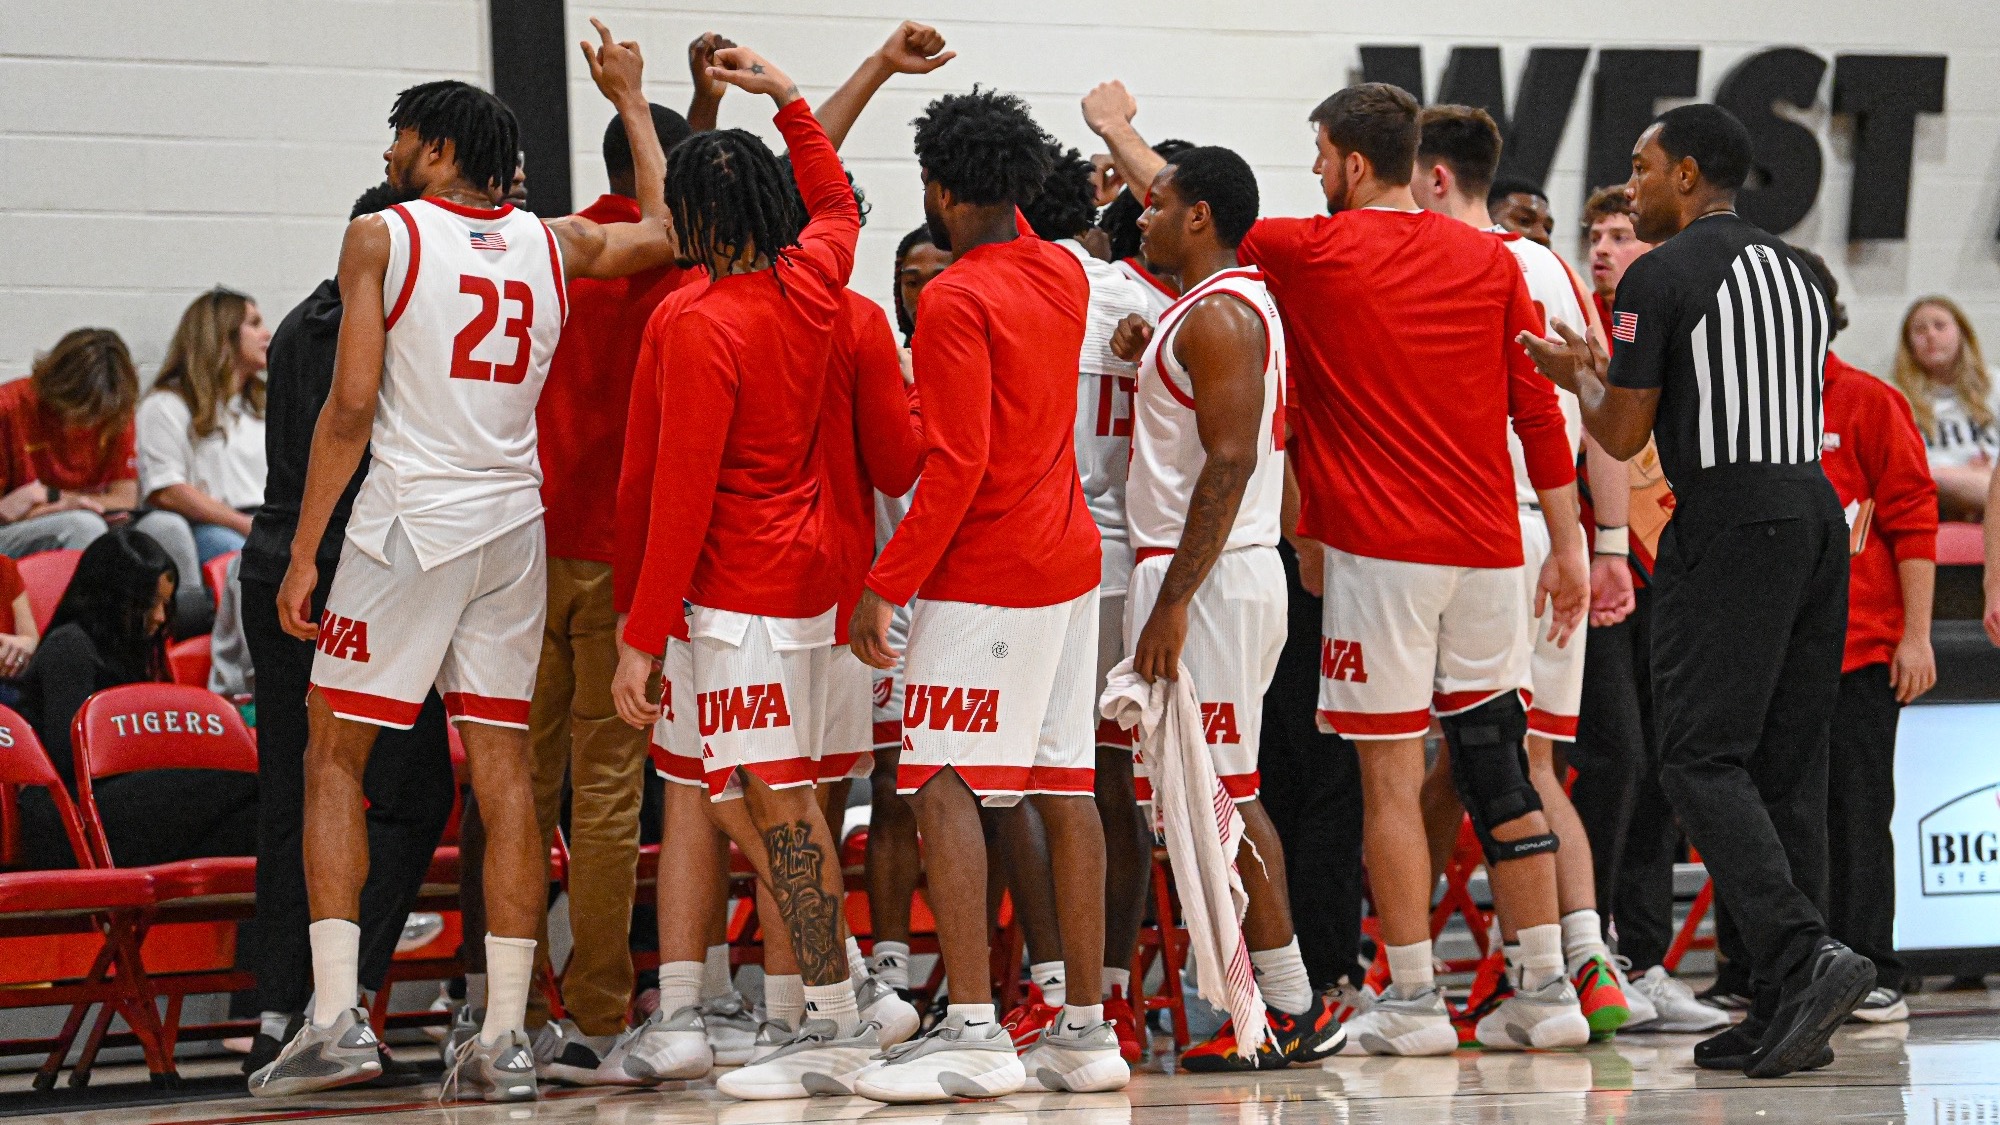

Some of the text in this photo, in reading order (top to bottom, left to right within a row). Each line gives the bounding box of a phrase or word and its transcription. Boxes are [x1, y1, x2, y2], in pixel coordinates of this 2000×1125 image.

[450, 273, 534, 385] 23
[316, 608, 371, 663] WA
[1321, 635, 1368, 683] WA
[110, 710, 225, 737] TIGERS
[697, 682, 791, 737] UWA
[903, 684, 1000, 733] UWA
[1929, 831, 1998, 866] BIG
